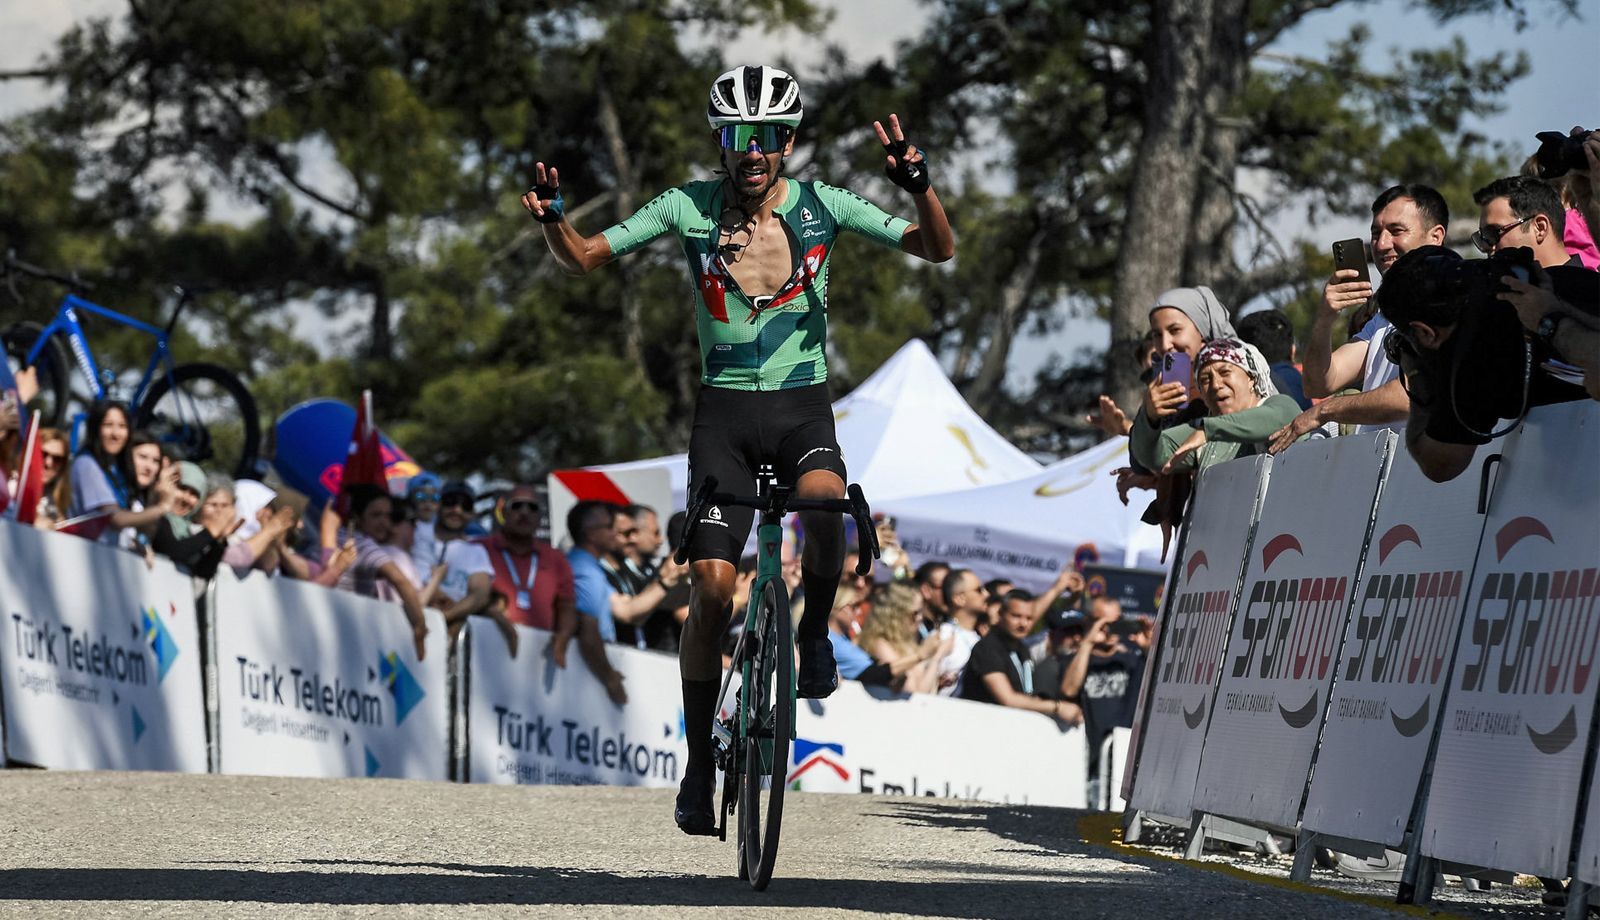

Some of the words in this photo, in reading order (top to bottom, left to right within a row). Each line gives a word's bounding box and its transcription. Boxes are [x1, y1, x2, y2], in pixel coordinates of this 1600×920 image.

[12, 613, 58, 666] Türk
[61, 624, 148, 687] Telekom
[236, 656, 285, 706] Türk
[290, 667, 383, 727] Telekom
[493, 704, 554, 758] Türk
[561, 718, 677, 782] Telekom
